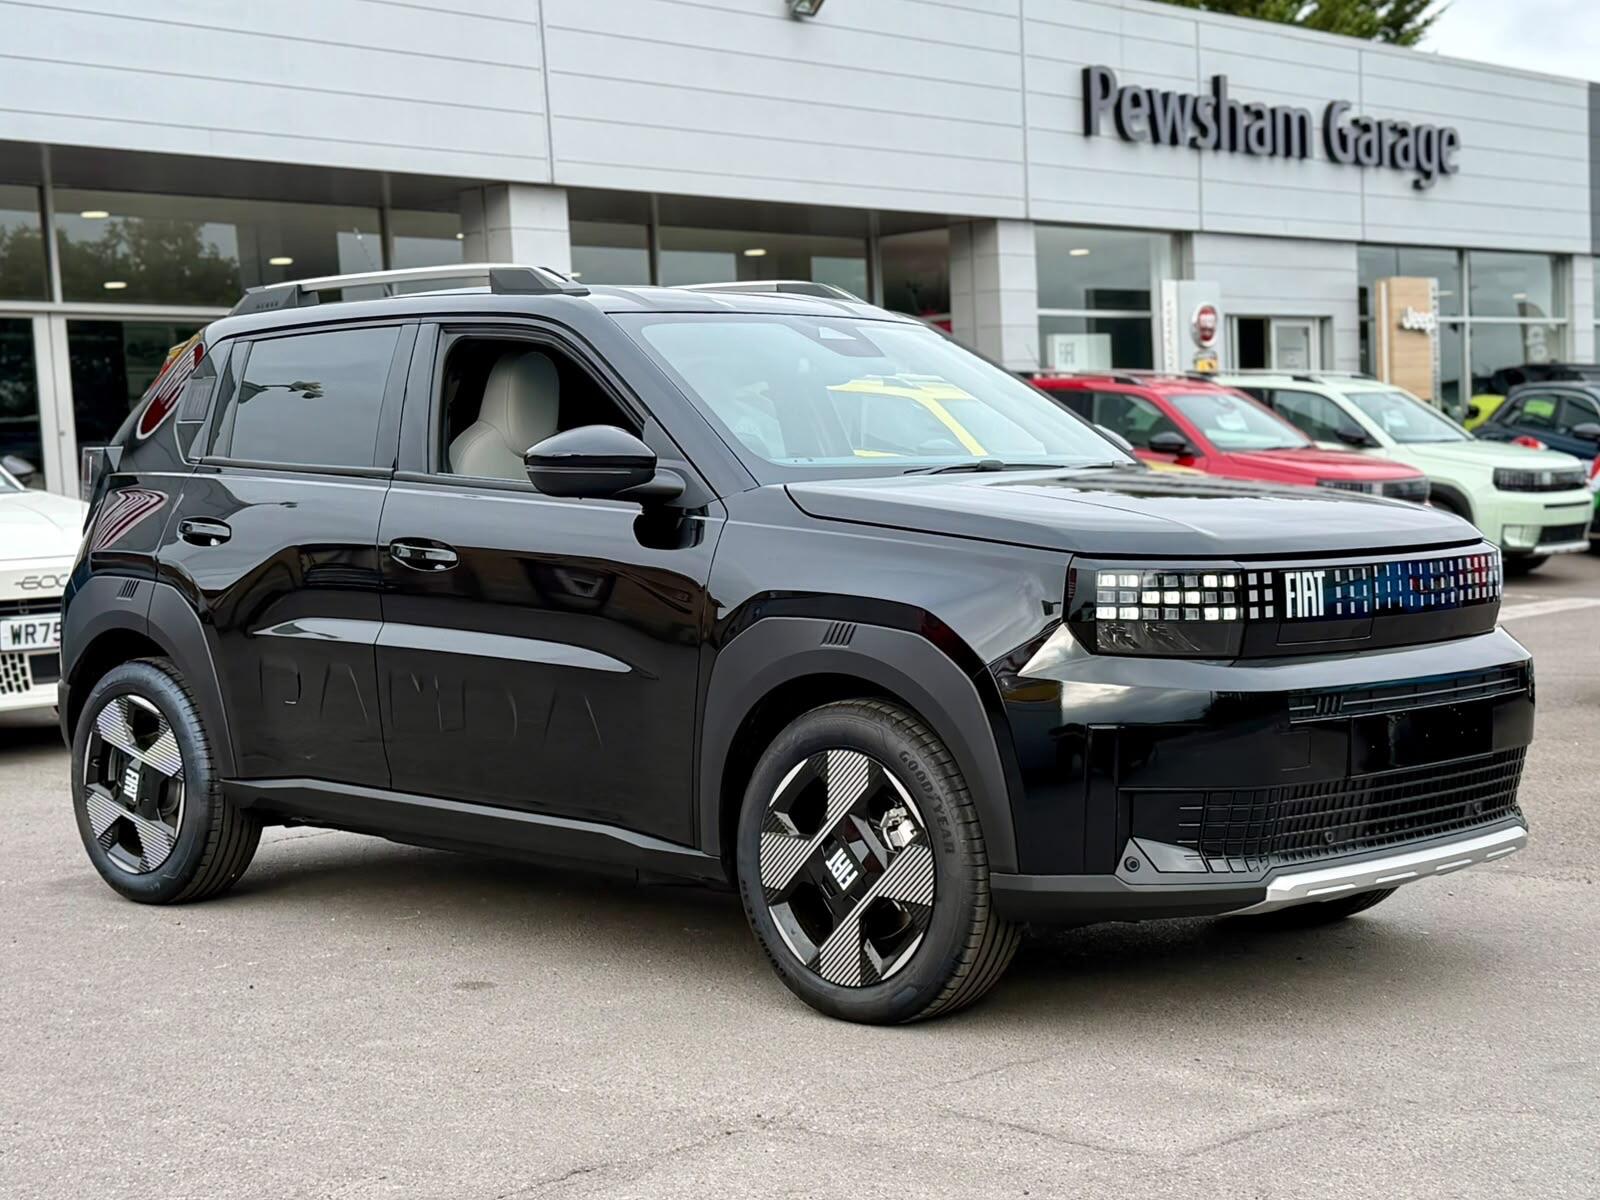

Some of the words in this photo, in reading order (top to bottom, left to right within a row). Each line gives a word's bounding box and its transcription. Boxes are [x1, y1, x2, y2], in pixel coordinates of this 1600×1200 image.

[1081, 64, 1314, 160] Pewsham
[1322, 98, 1462, 191] Garage
[1402, 306, 1436, 336] Jeep
[1284, 570, 1326, 618] FIAT
[10, 621, 61, 645] WR75
[122, 767, 140, 802] FIAT
[898, 750, 956, 855] GOODYEAR
[825, 847, 859, 891] FIAT
